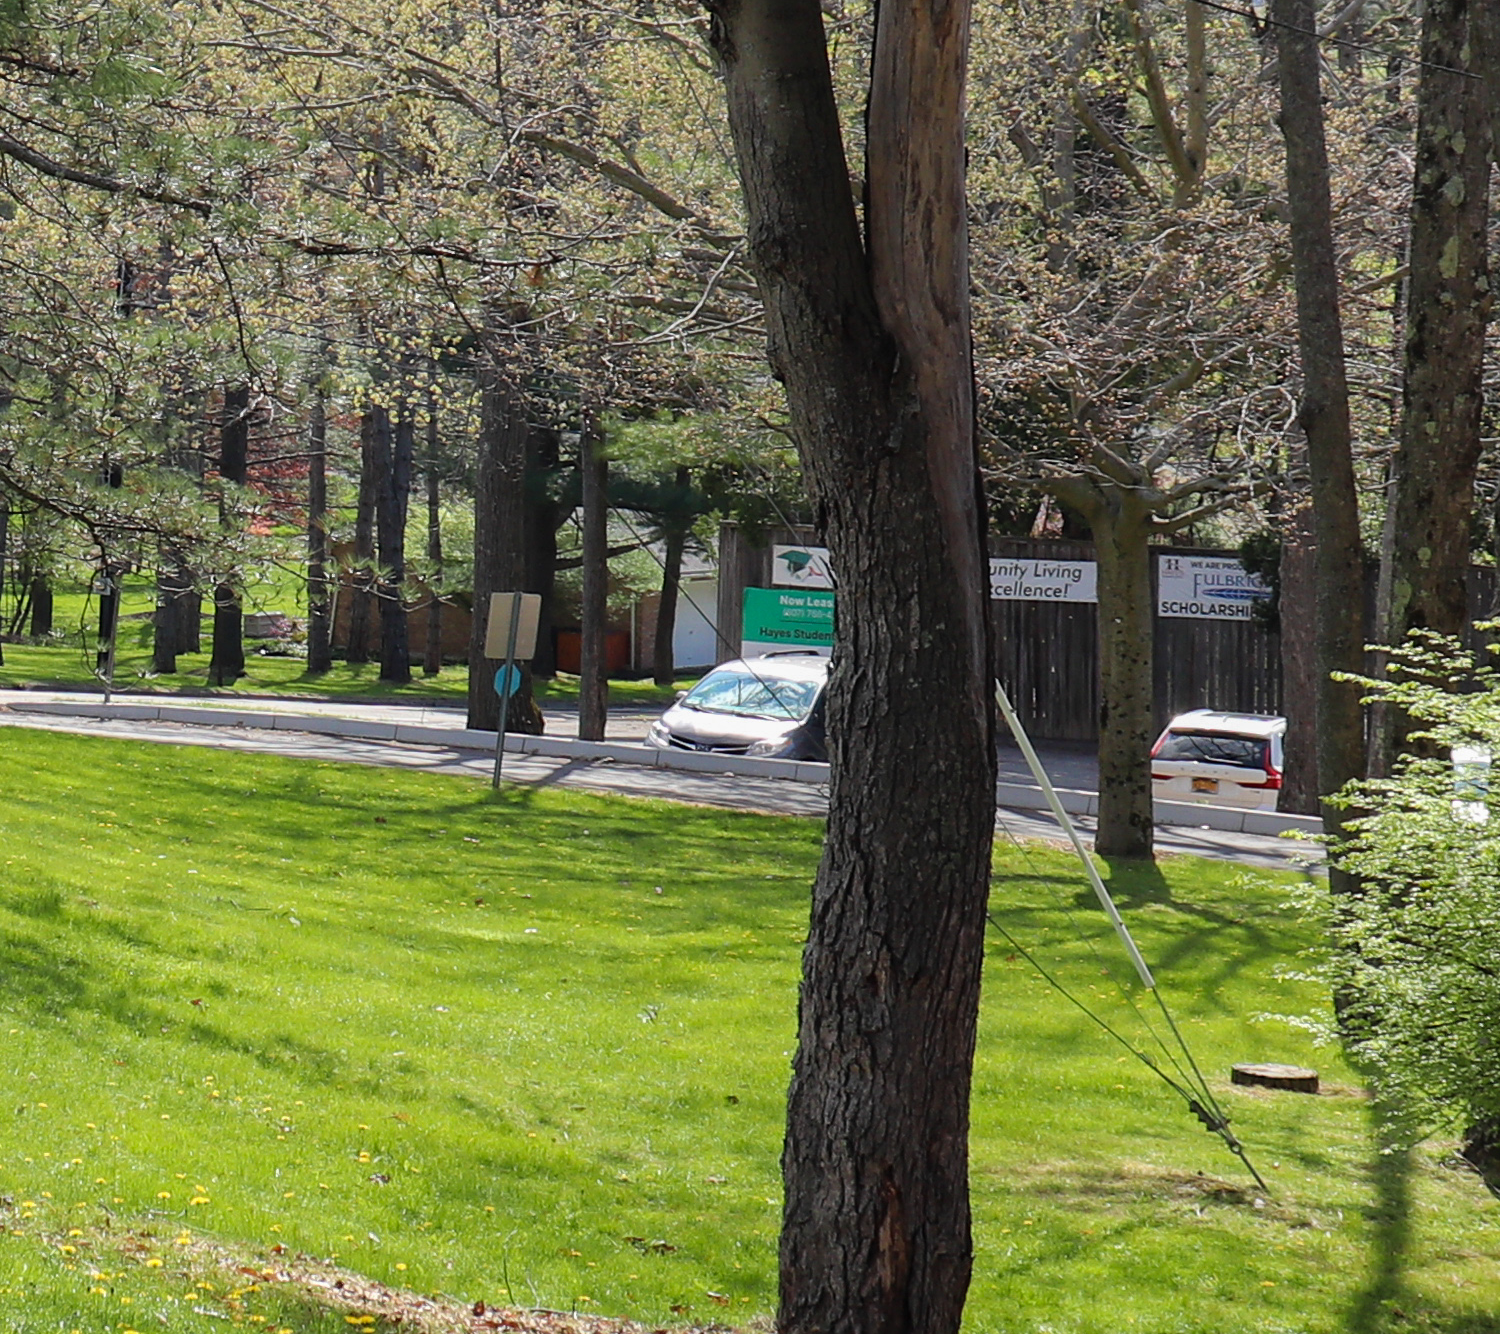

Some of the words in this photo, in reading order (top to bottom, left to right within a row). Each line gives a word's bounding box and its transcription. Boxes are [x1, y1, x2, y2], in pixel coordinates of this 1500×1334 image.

[989, 563, 1028, 580] unity
[1034, 563, 1082, 583] Living
[1190, 561, 1203, 569] WE
[1206, 562, 1220, 570] ARE
[993, 581, 1069, 598] cellence!
[1194, 573, 1264, 598] FULBRIG
[780, 595, 805, 606] Now
[807, 597, 834, 607] Leas
[760, 627, 791, 639] Hayes
[794, 629, 832, 641] Studen
